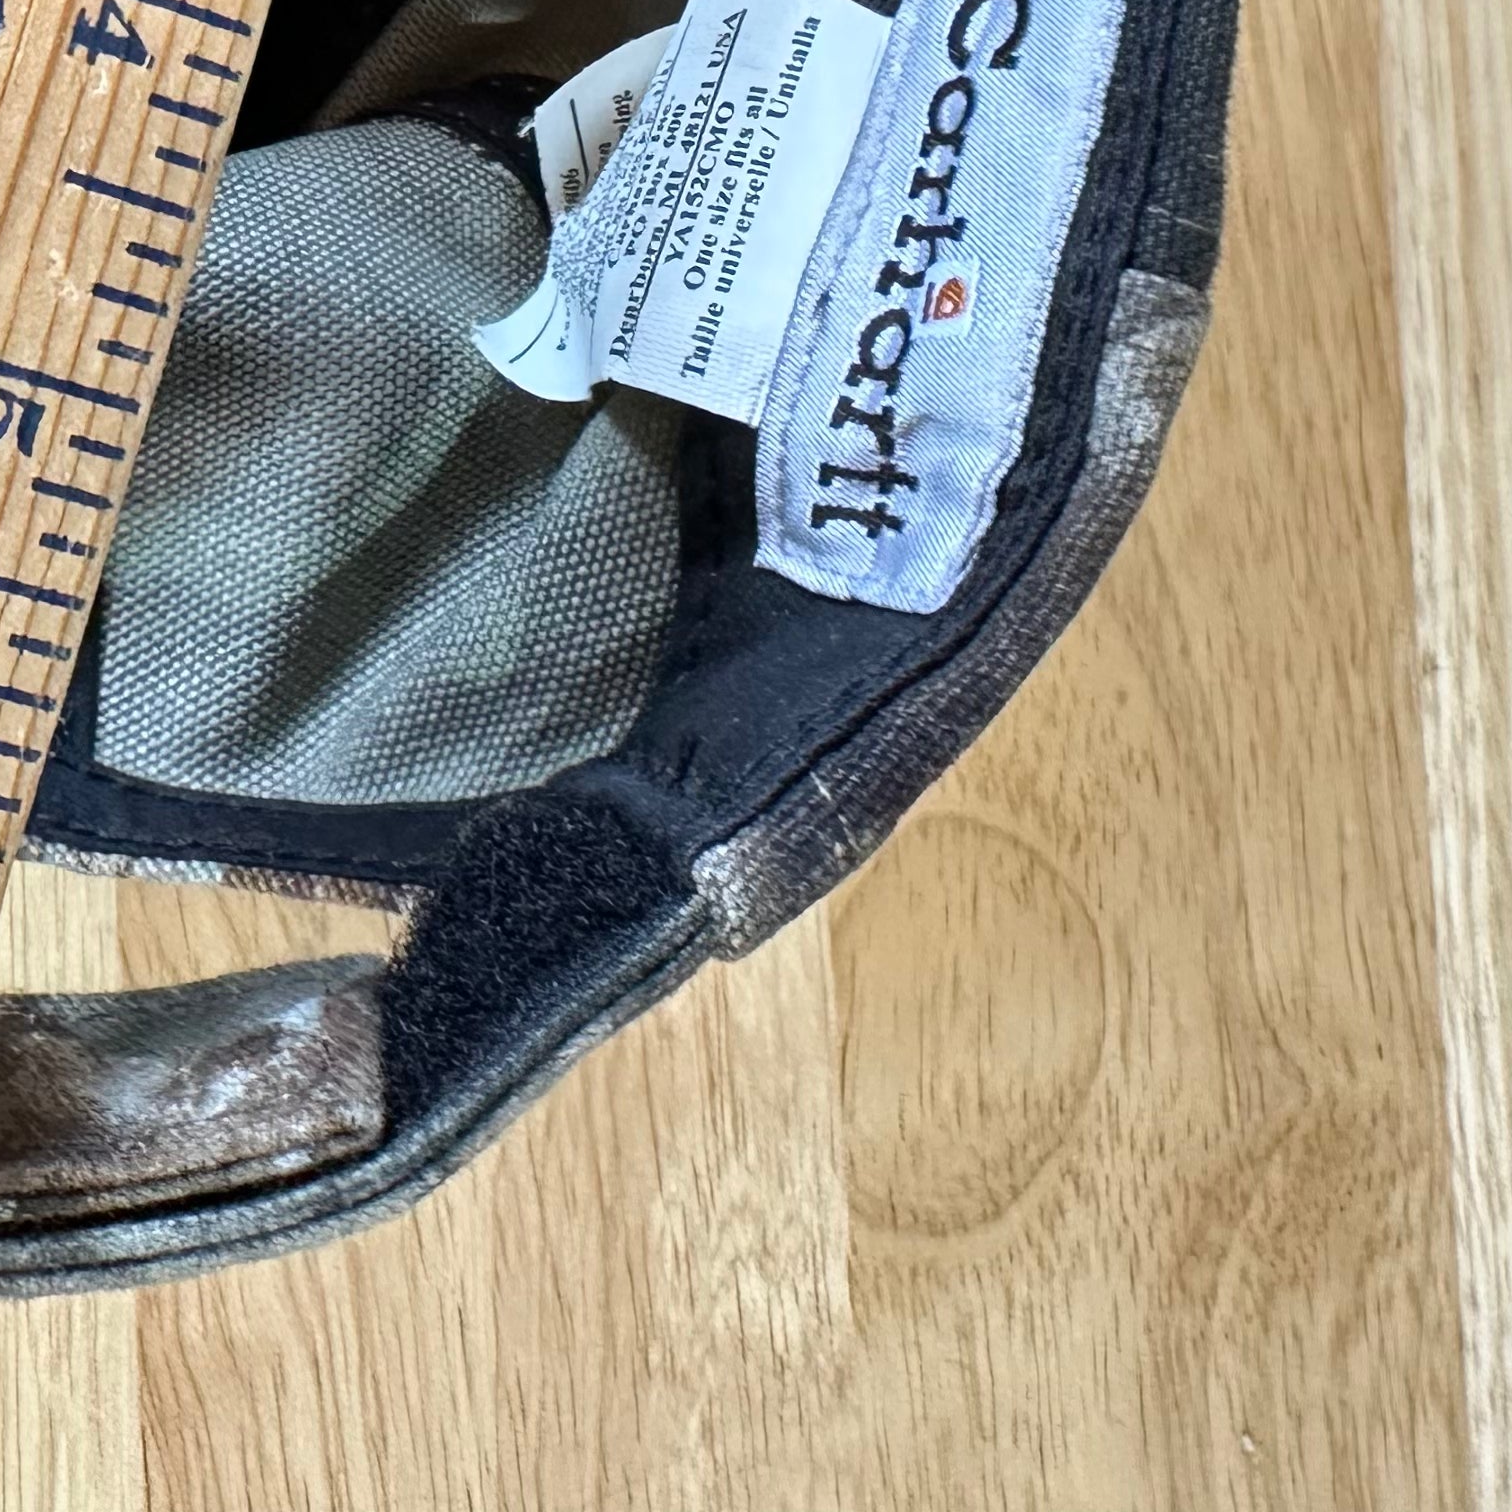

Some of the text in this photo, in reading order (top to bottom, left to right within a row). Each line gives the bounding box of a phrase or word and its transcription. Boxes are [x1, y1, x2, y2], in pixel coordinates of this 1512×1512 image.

[609, 9, 747, 362] Dearborn, MI 48121 USA
[624, 215, 647, 256] PO
[642, 155, 670, 205] Box
[681, 301, 724, 378] Taille
[714, 145, 776, 294] universelle
[766, 16, 821, 120] Unitalla
[684, 86, 768, 290] One size fits all
